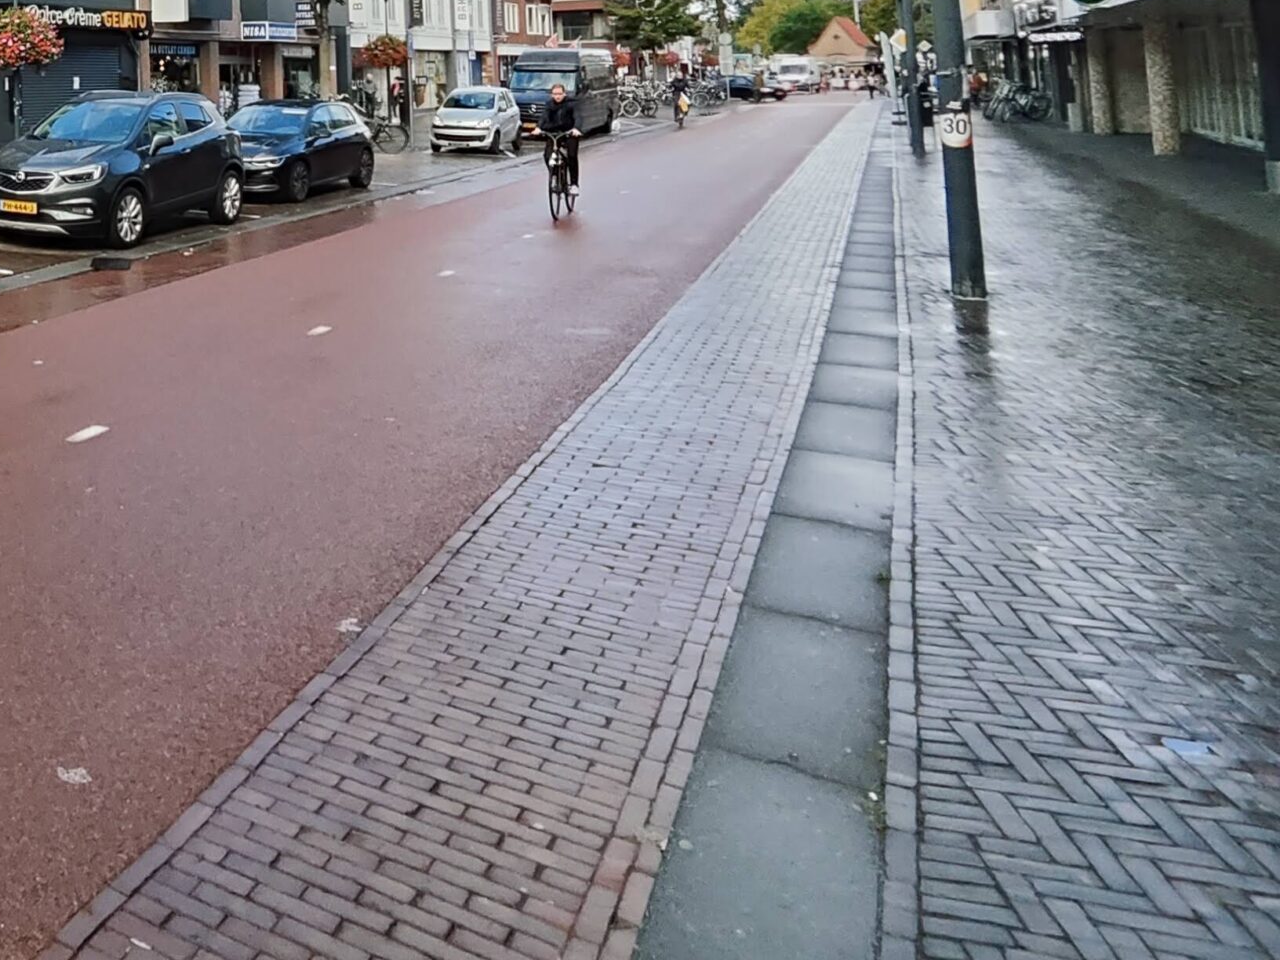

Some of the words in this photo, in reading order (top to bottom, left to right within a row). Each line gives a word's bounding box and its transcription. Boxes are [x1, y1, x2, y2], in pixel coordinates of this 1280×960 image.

[103, 11, 147, 29] GELATO
[243, 23, 267, 39] NISA
[943, 117, 968, 136] 30
